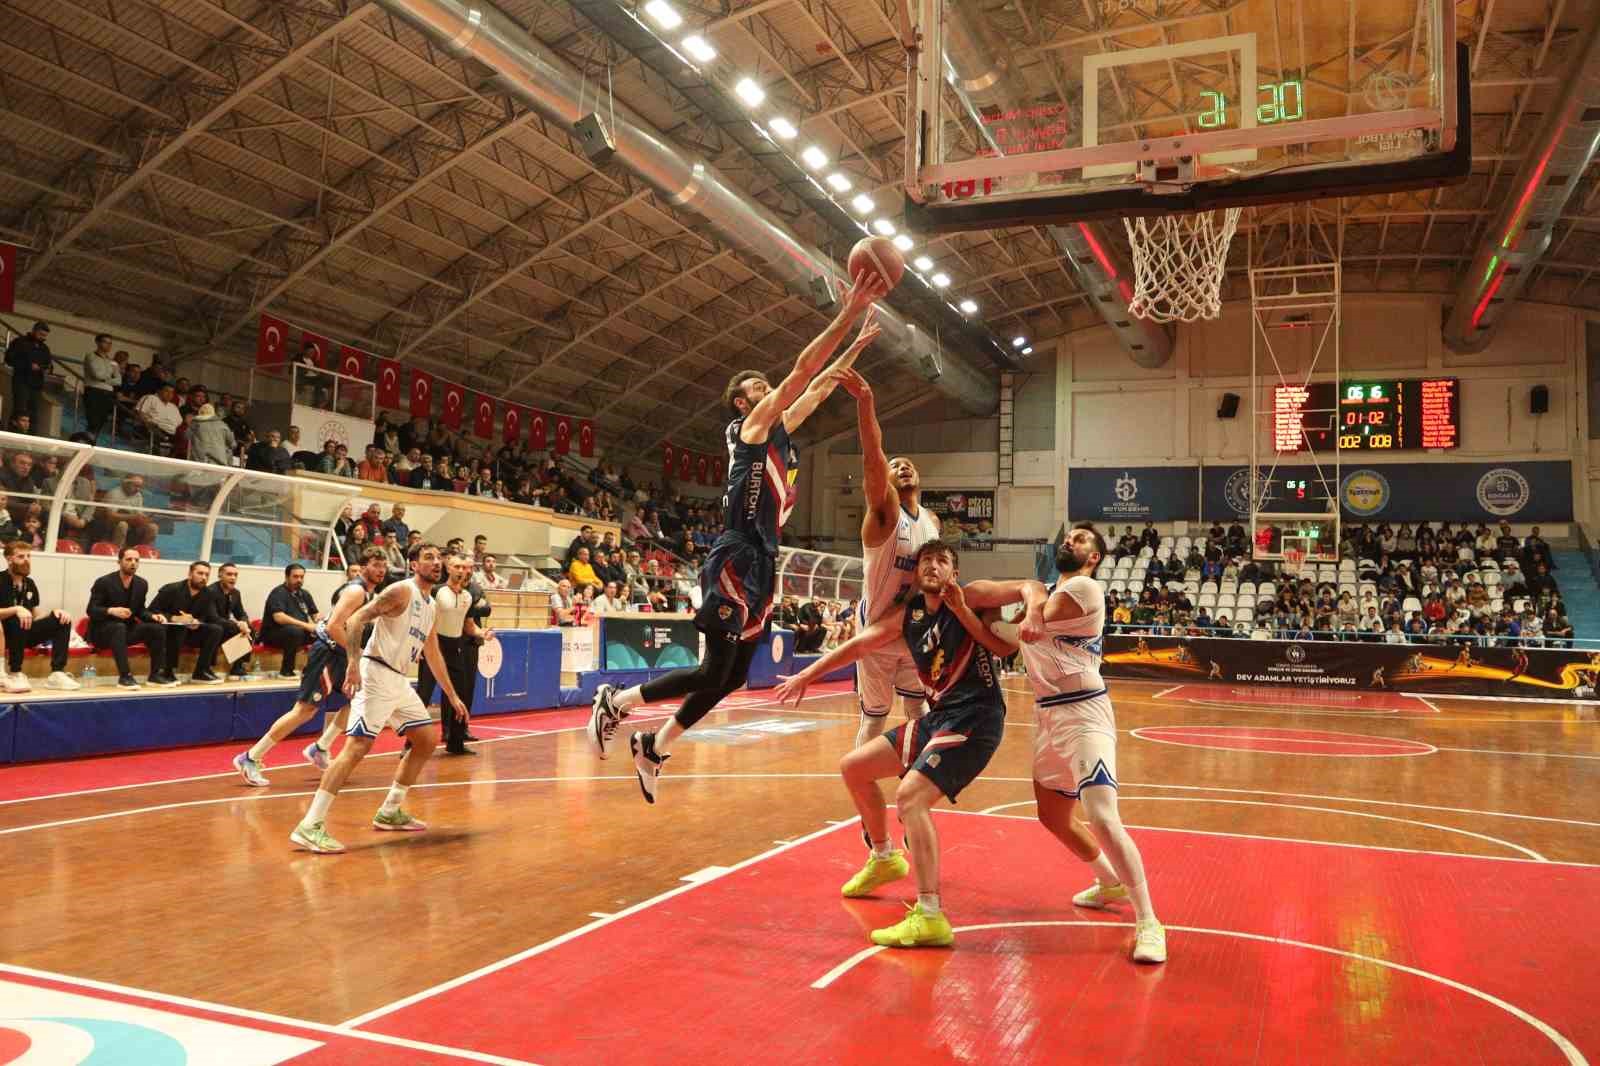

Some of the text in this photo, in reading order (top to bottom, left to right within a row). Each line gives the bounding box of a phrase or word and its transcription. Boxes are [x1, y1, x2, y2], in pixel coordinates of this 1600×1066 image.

[1339, 434, 1392, 449] 002 008
[1236, 673, 1252, 681] DEV
[1254, 675, 1292, 683] ADAMLAR
